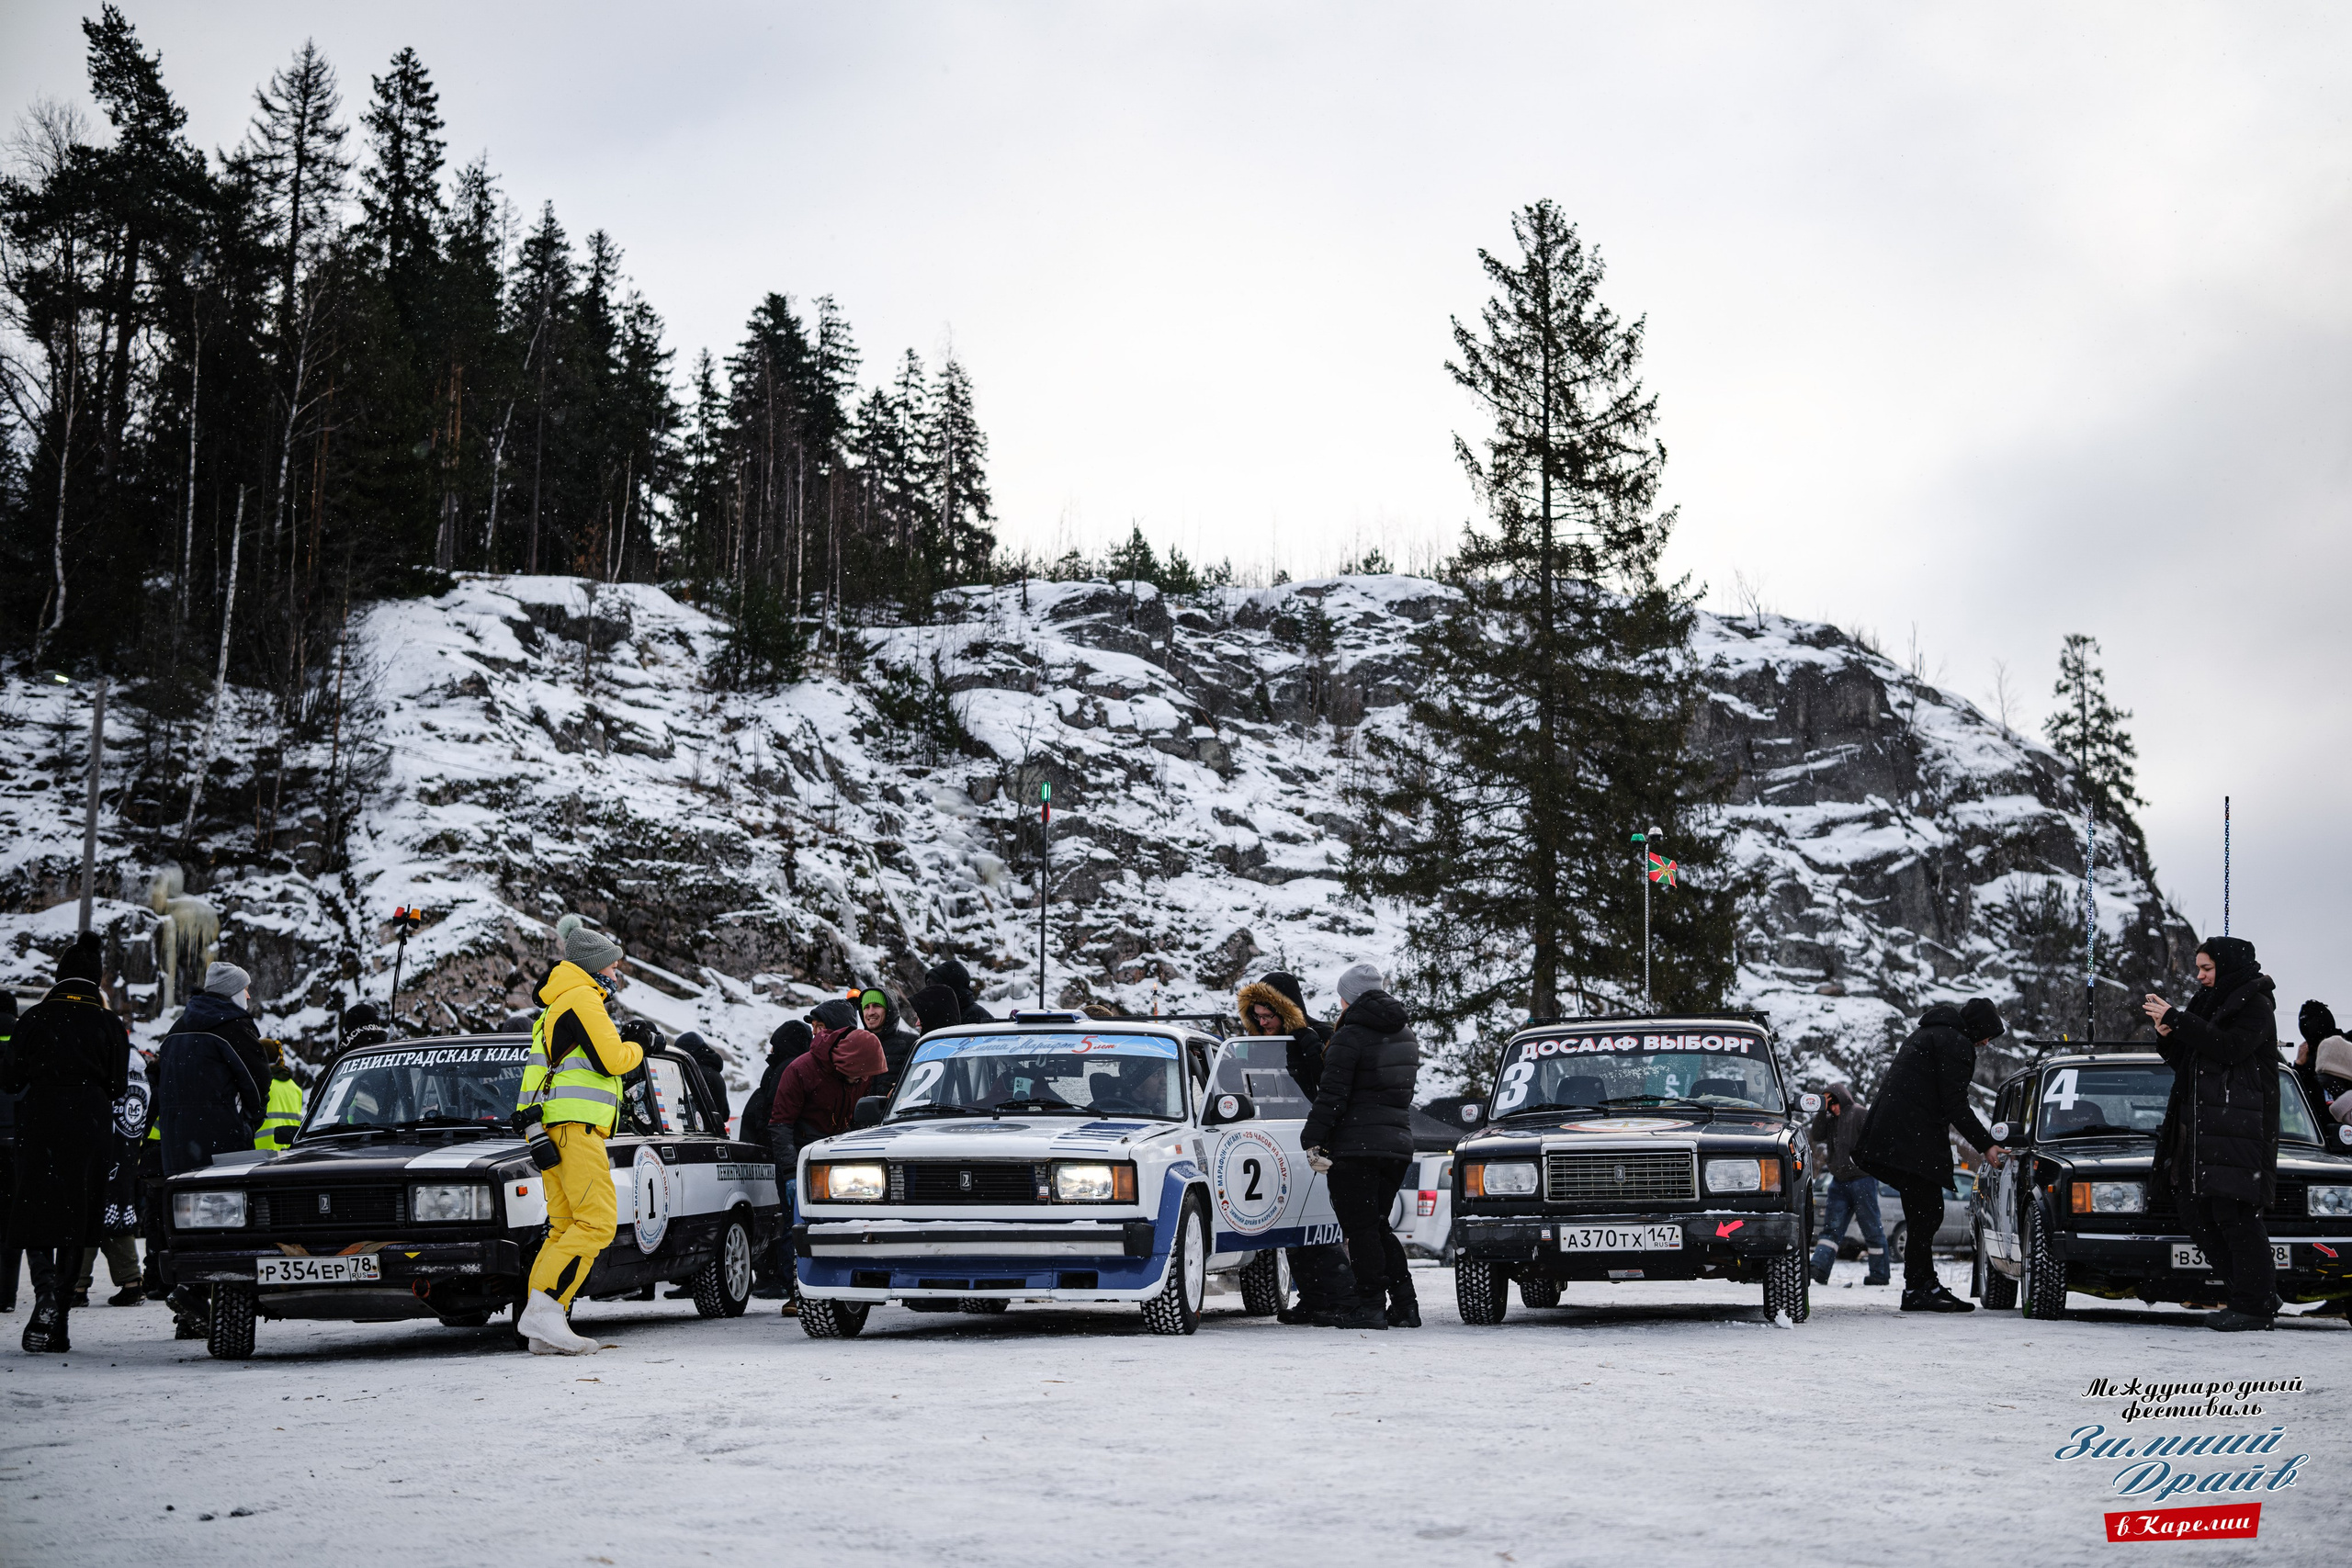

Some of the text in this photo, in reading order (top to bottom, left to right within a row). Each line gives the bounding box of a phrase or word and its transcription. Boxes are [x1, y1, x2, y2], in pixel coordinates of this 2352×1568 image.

[339, 1027, 364, 1048] LACK
[1071, 1035, 1098, 1054] 5
[1519, 1035, 1755, 1062] ДОСААФ ВЫБОРГ
[338, 1048, 482, 1076] ЛЕНИНГРАДСКАЯ
[484, 1047, 531, 1063] КЛАС
[312, 1077, 354, 1127] 1
[898, 1061, 944, 1111] 2
[1496, 1062, 1535, 1111] 3
[2043, 1069, 2079, 1111] 4
[1216, 1132, 1242, 1186] МАРАФОН-ГИГАНТ
[1253, 1132, 1272, 1148] ЧАСОВ
[1272, 1146, 1279, 1157] НА
[1243, 1158, 1262, 1201] 2
[648, 1178, 656, 1220] 1
[1304, 1224, 1343, 1247] LADA
[1647, 1227, 1676, 1241] 147
[350, 1258, 371, 1272] 78
